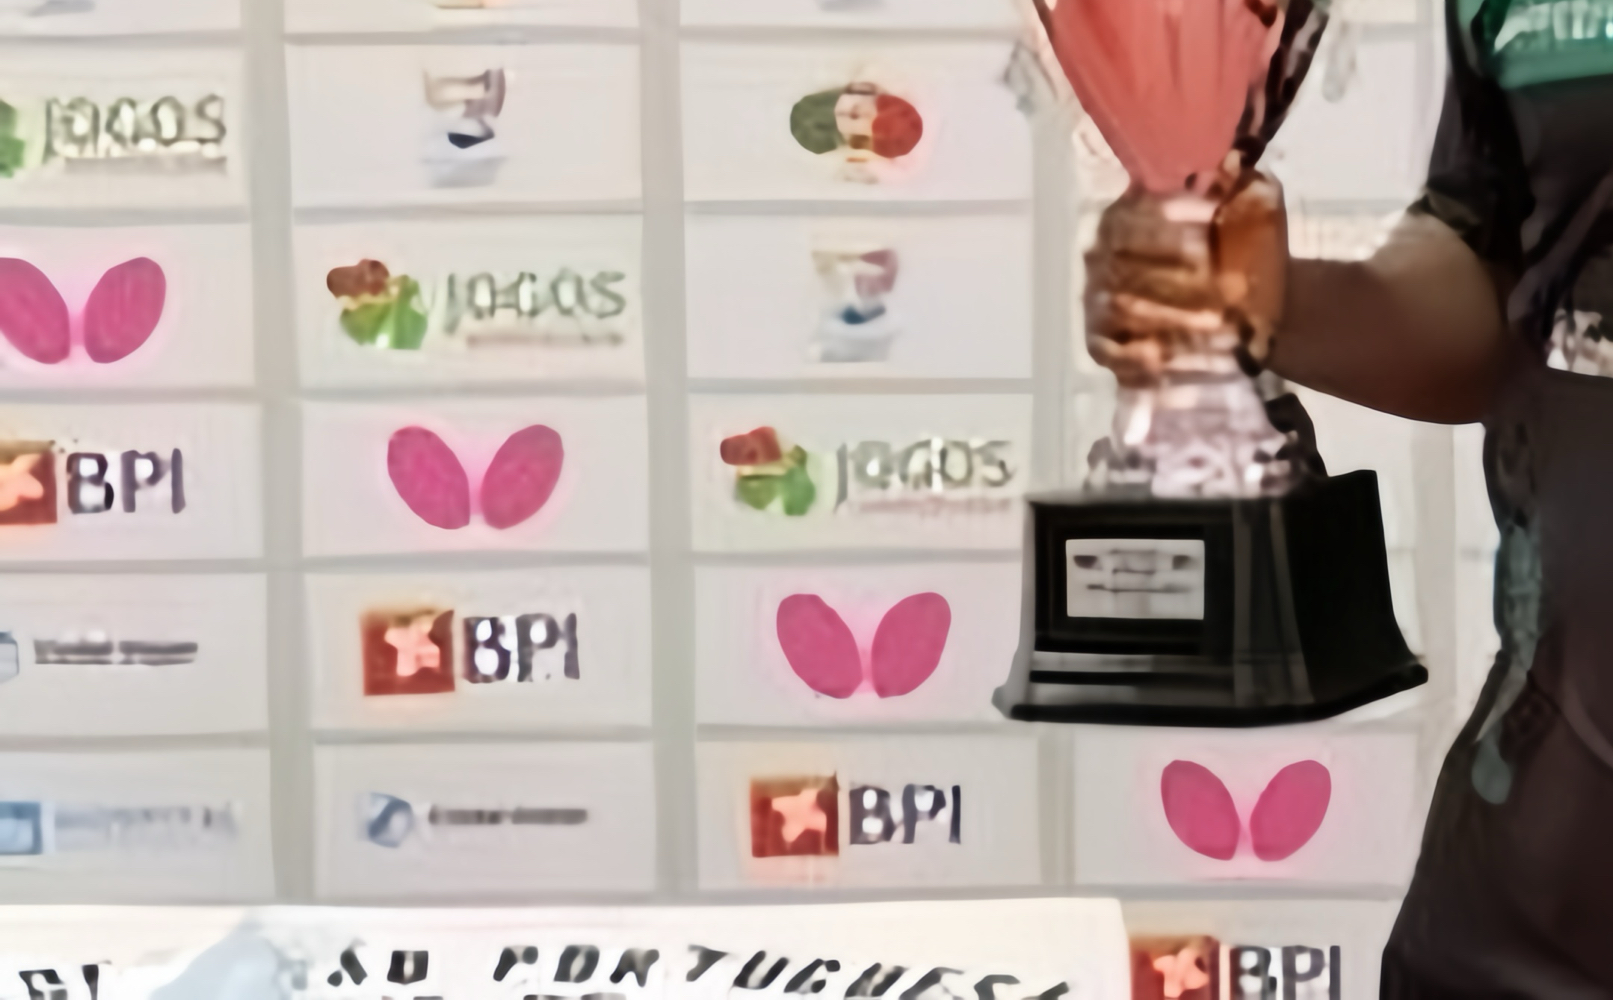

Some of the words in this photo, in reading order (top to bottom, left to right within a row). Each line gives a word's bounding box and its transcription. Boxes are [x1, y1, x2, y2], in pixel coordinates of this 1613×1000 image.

[66, 448, 187, 515] BPI
[463, 612, 581, 684] BPI
[848, 783, 962, 845] BPI
[1229, 944, 1341, 1000] BPI
